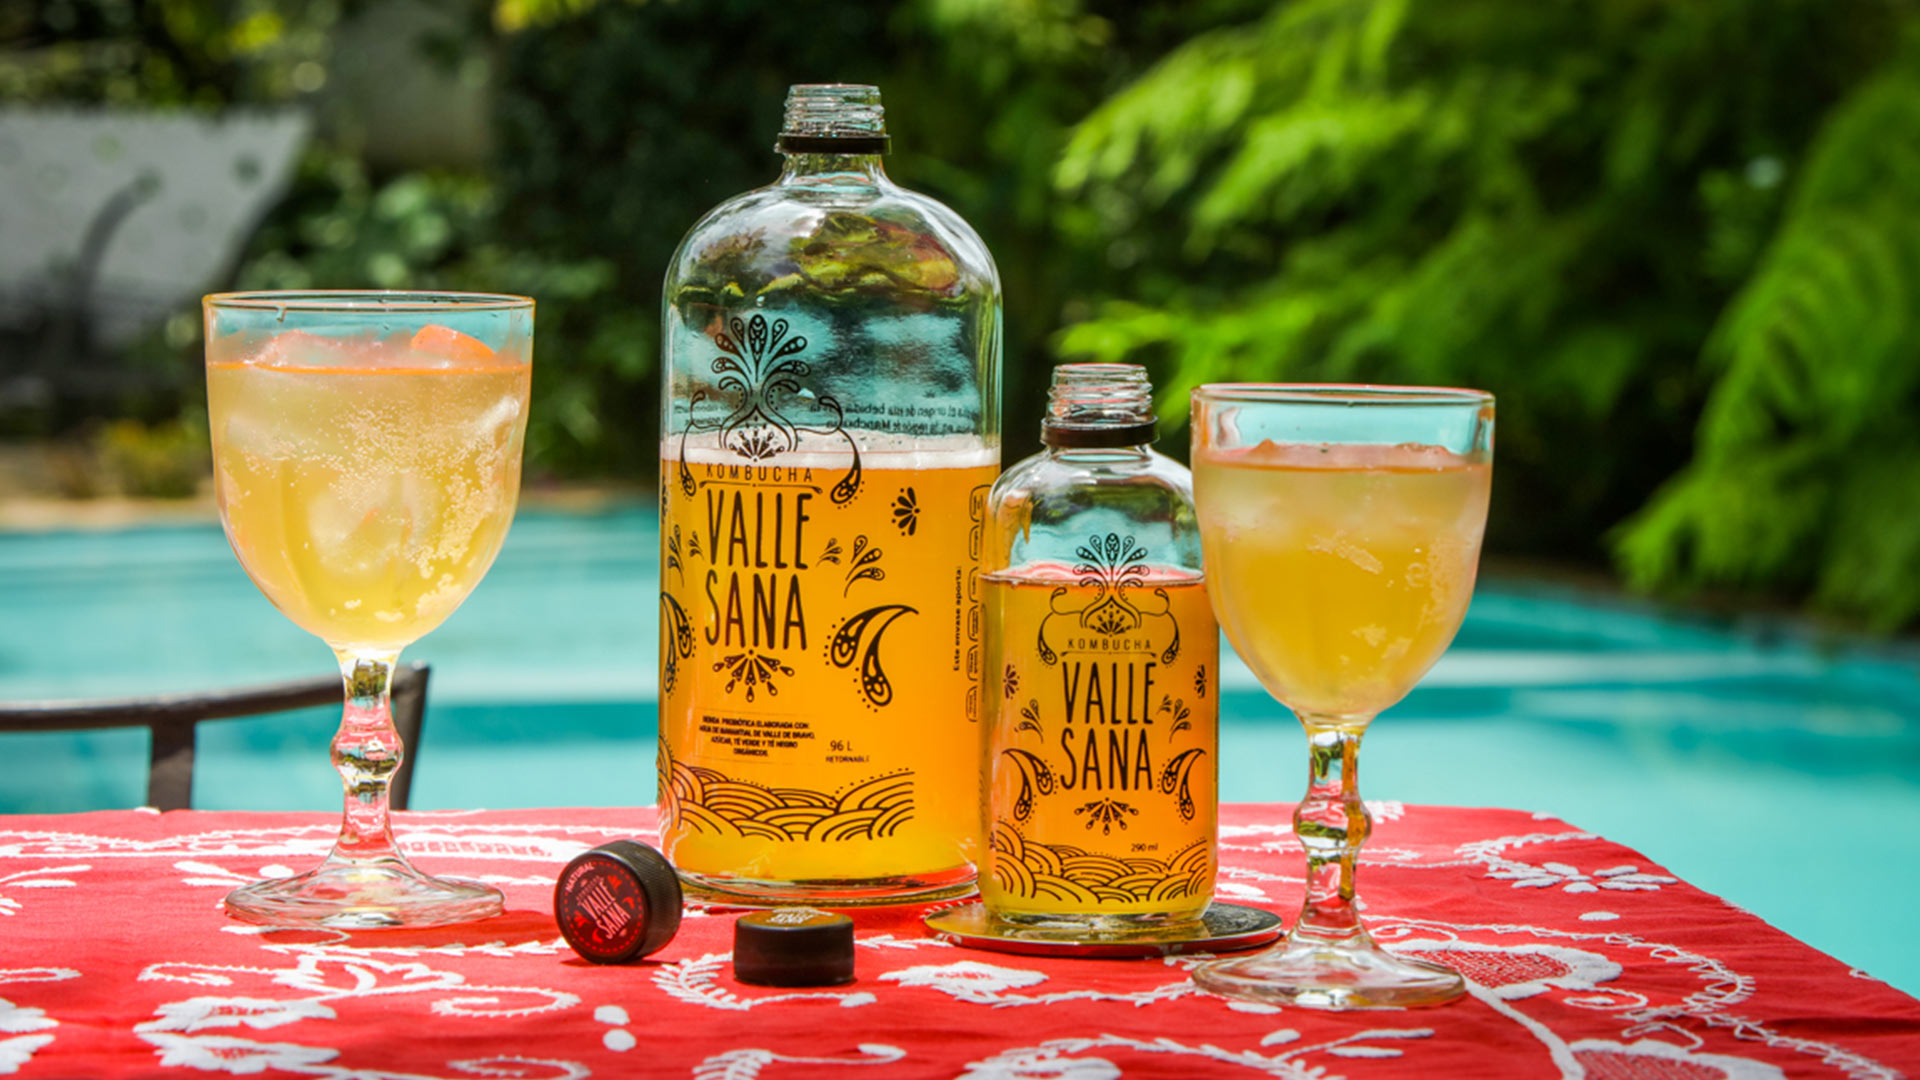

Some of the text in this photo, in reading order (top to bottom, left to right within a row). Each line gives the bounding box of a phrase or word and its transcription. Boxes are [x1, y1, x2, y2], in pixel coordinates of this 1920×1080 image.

[706, 463, 813, 482] KOMBUCHA
[706, 488, 814, 570] VALLE
[705, 571, 808, 651] SANA
[954, 608, 962, 646] envase
[952, 648, 961, 671] Este
[1067, 639, 1153, 651] KOMBUCHA
[1062, 662, 1158, 726] VALLE
[753, 728, 761, 737] DE
[762, 730, 781, 739] VALLE
[782, 731, 791, 739] DE
[794, 721, 810, 729] CON
[846, 739, 854, 752] L
[1060, 728, 1154, 791] SANA
[1130, 842, 1159, 853] 290 ml
[565, 861, 595, 893] NATURAL
[577, 877, 616, 921] VALLE
[596, 902, 631, 940] SANA
